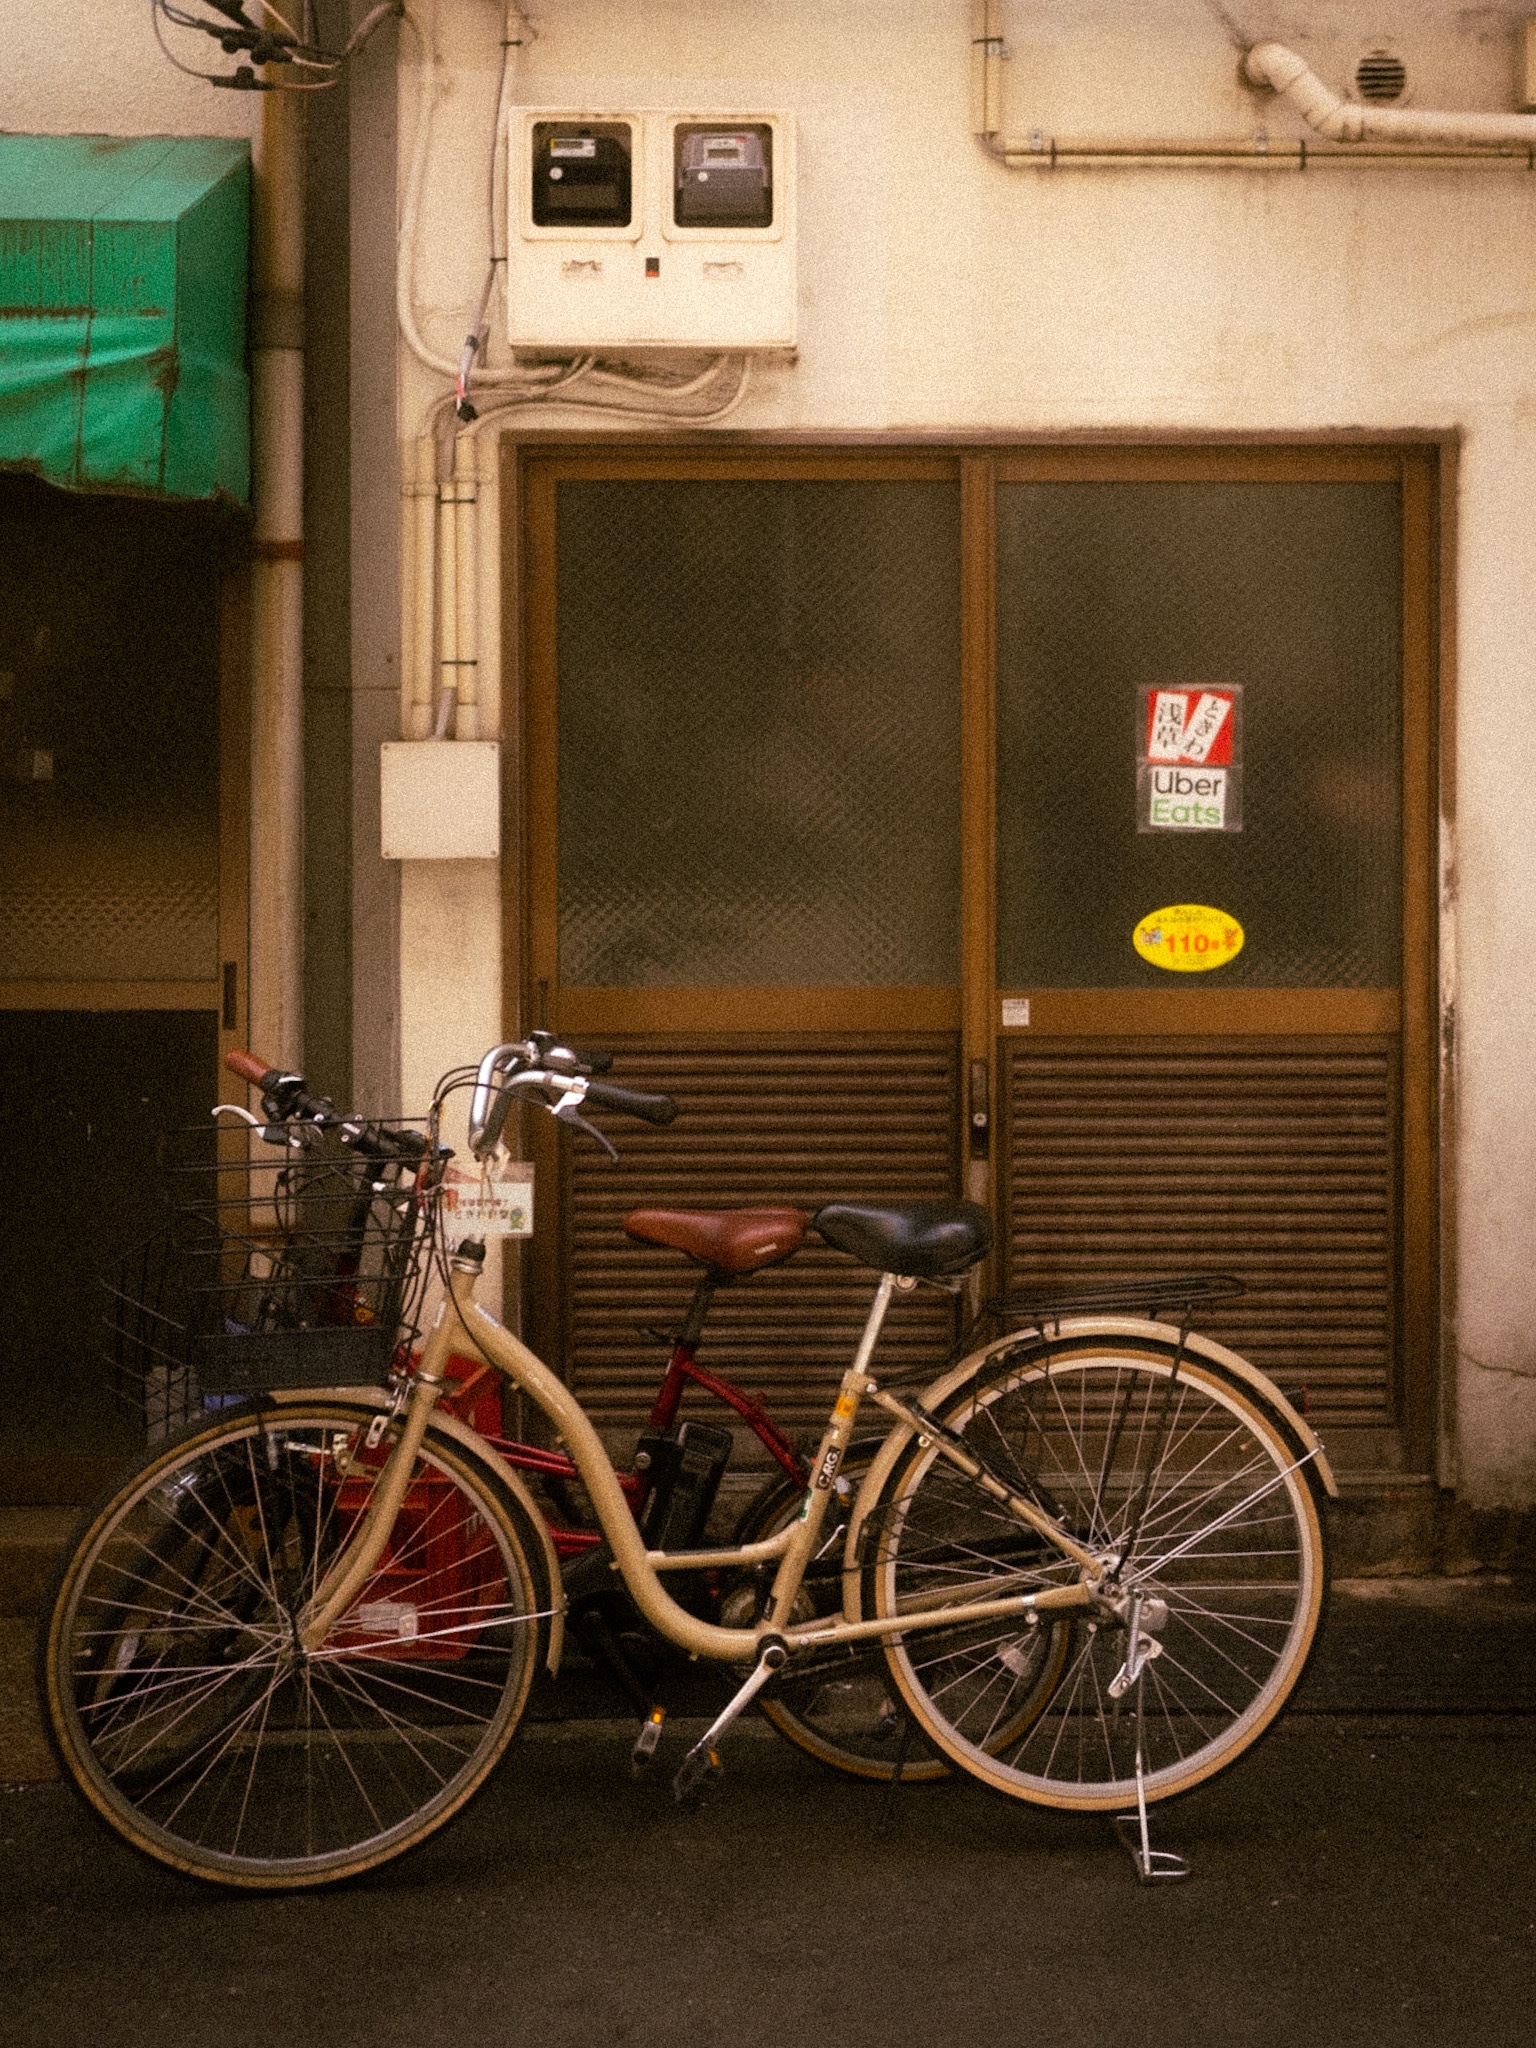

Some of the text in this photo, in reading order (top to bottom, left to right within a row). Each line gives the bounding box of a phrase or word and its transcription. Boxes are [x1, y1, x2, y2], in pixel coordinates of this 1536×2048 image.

[1156, 701, 1182, 749] 浅草
[1184, 699, 1220, 755] ときわ
[1154, 771, 1222, 796] Uber
[1153, 798, 1221, 824] Eats
